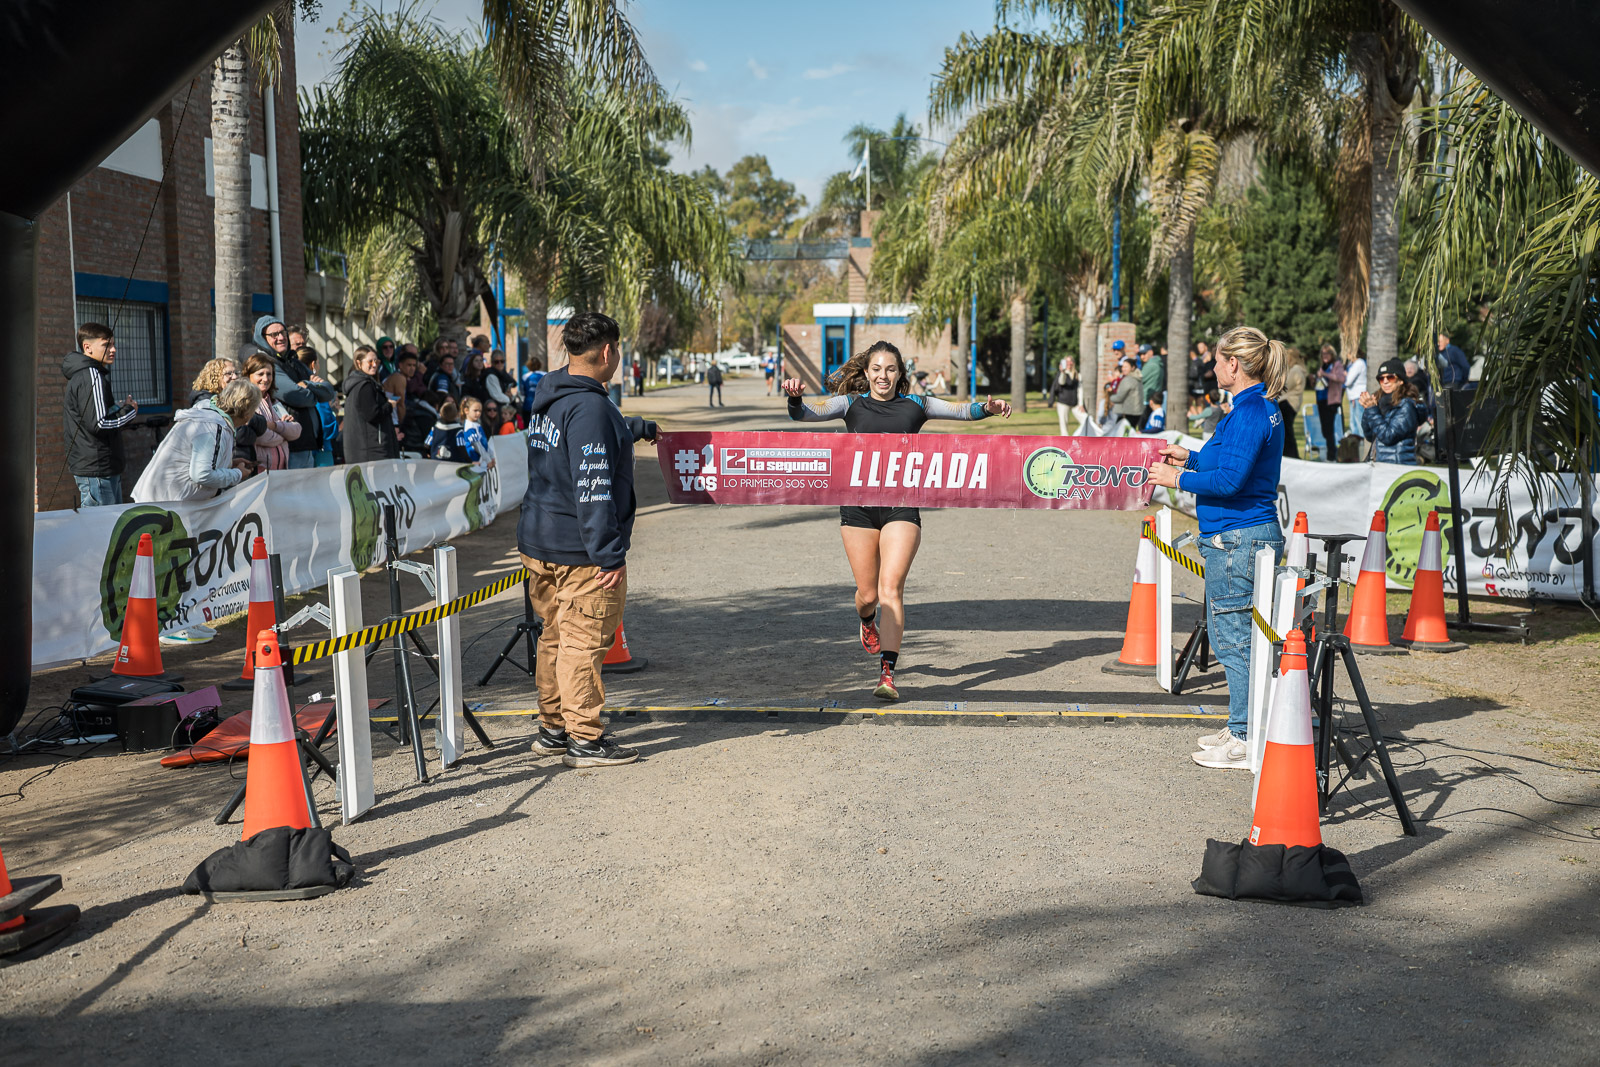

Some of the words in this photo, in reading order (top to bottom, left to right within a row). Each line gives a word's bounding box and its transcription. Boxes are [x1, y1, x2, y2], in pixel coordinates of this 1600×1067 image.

[581, 442, 593, 456] El
[593, 442, 607, 456] club
[777, 450, 828, 458] ASEGURADOR
[579, 458, 588, 471] de
[674, 444, 717, 474] #1
[749, 459, 765, 471] La
[766, 459, 827, 473] segunda
[849, 450, 989, 489] LLEGADA
[679, 475, 717, 491] VOS
[723, 478, 738, 488] LO
[740, 478, 783, 488] PRIMERO
[785, 479, 806, 489] SOS
[808, 479, 829, 489] VOS
[579, 491, 591, 503] del
[1056, 488, 1095, 500] RAV
